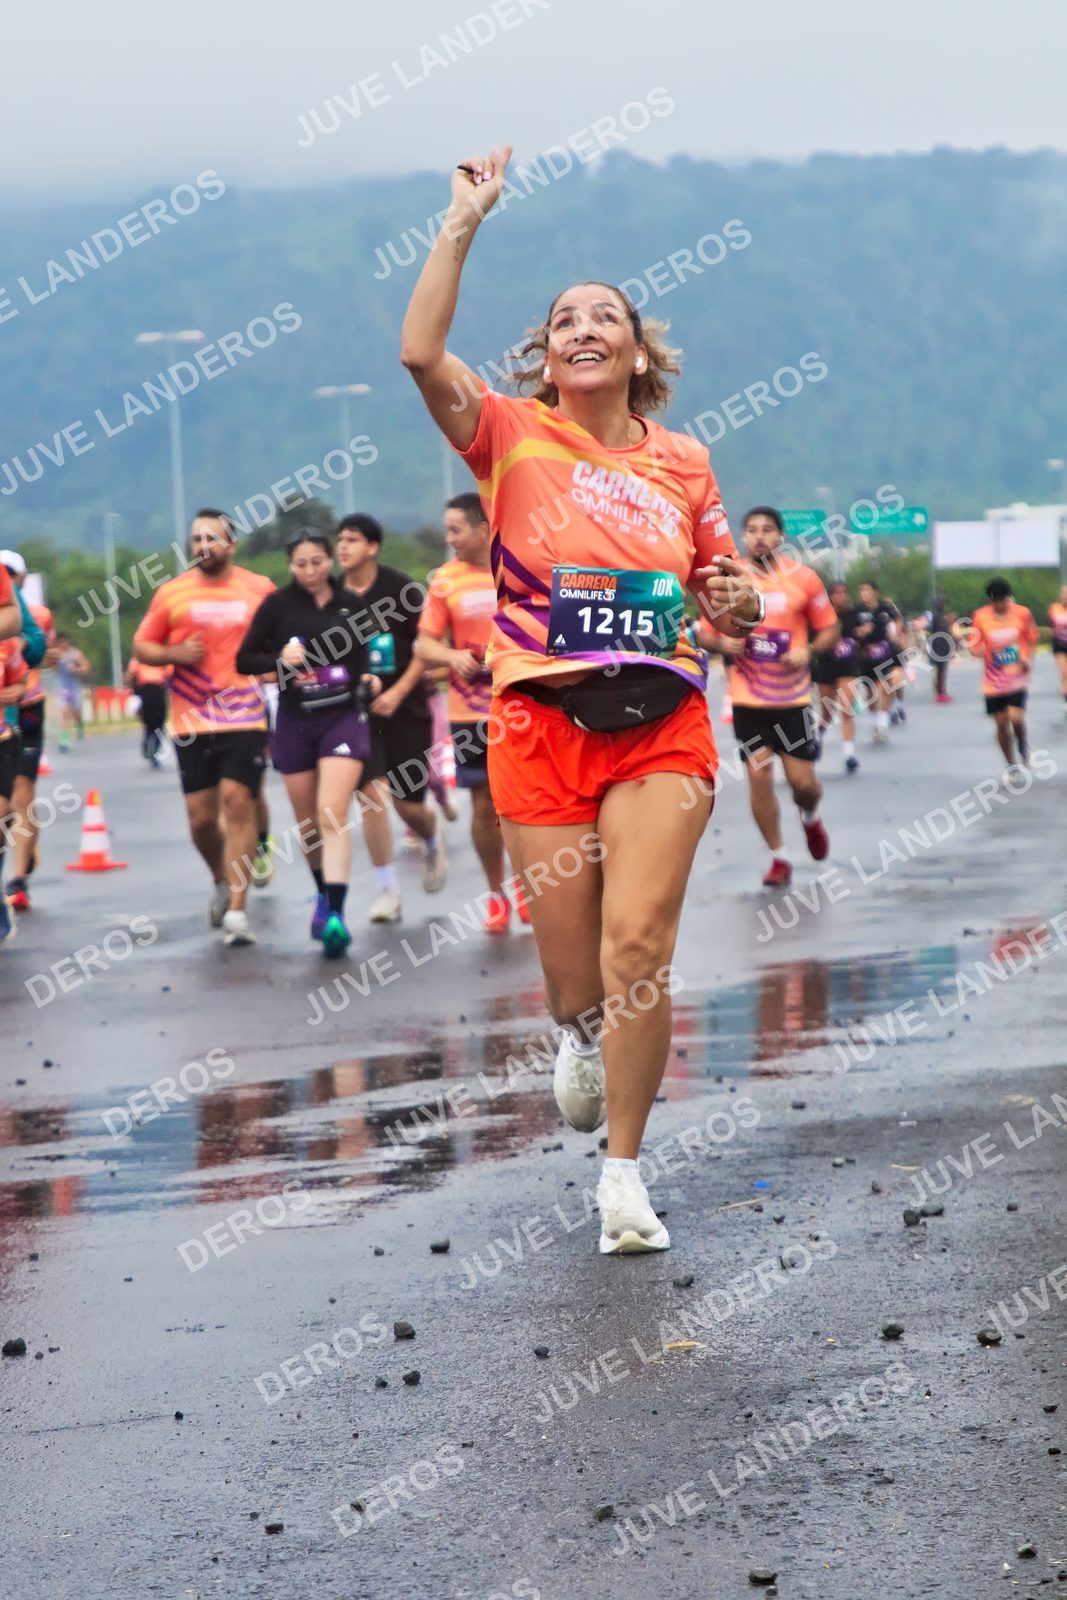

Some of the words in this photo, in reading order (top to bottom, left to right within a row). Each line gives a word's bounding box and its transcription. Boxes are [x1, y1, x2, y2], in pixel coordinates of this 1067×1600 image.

[571, 488, 658, 530] OMNILIFE
[560, 573, 617, 590] CARRERA
[652, 578, 674, 597] 10K
[559, 588, 603, 601] OMNILIFE
[577, 606, 655, 637] 1215
